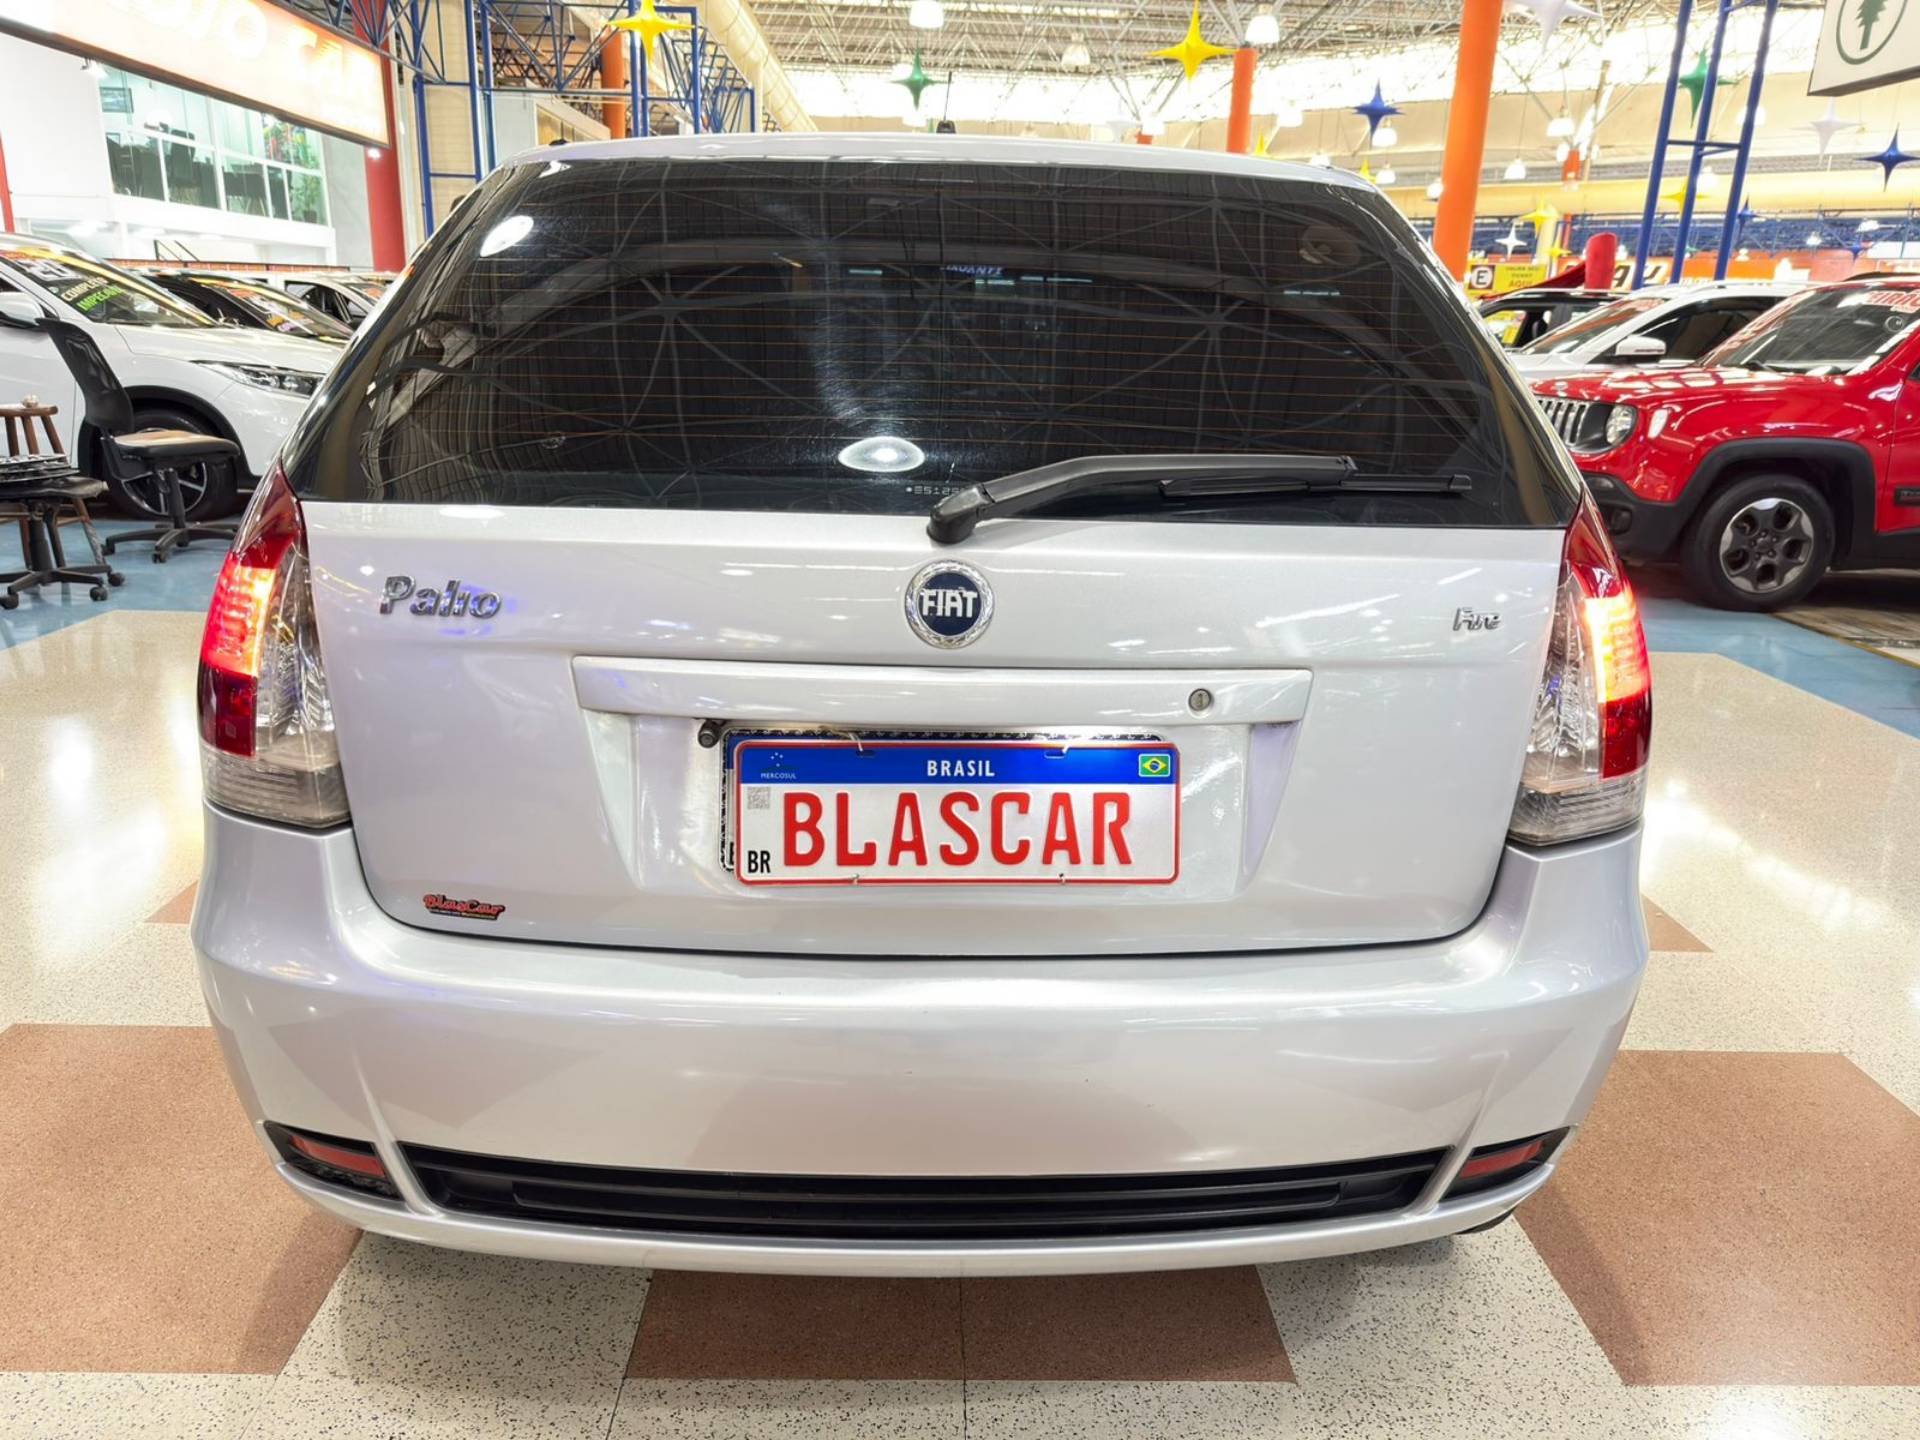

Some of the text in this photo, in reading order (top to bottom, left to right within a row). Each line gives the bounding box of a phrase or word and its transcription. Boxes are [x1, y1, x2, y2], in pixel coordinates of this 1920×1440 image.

[379, 575, 501, 619] Palio
[920, 588, 978, 618] FIAT
[760, 772, 797, 780] MERCOSUL
[926, 759, 996, 777] BRASIL
[783, 791, 1132, 867] BLASCAR
[747, 850, 771, 874] BR
